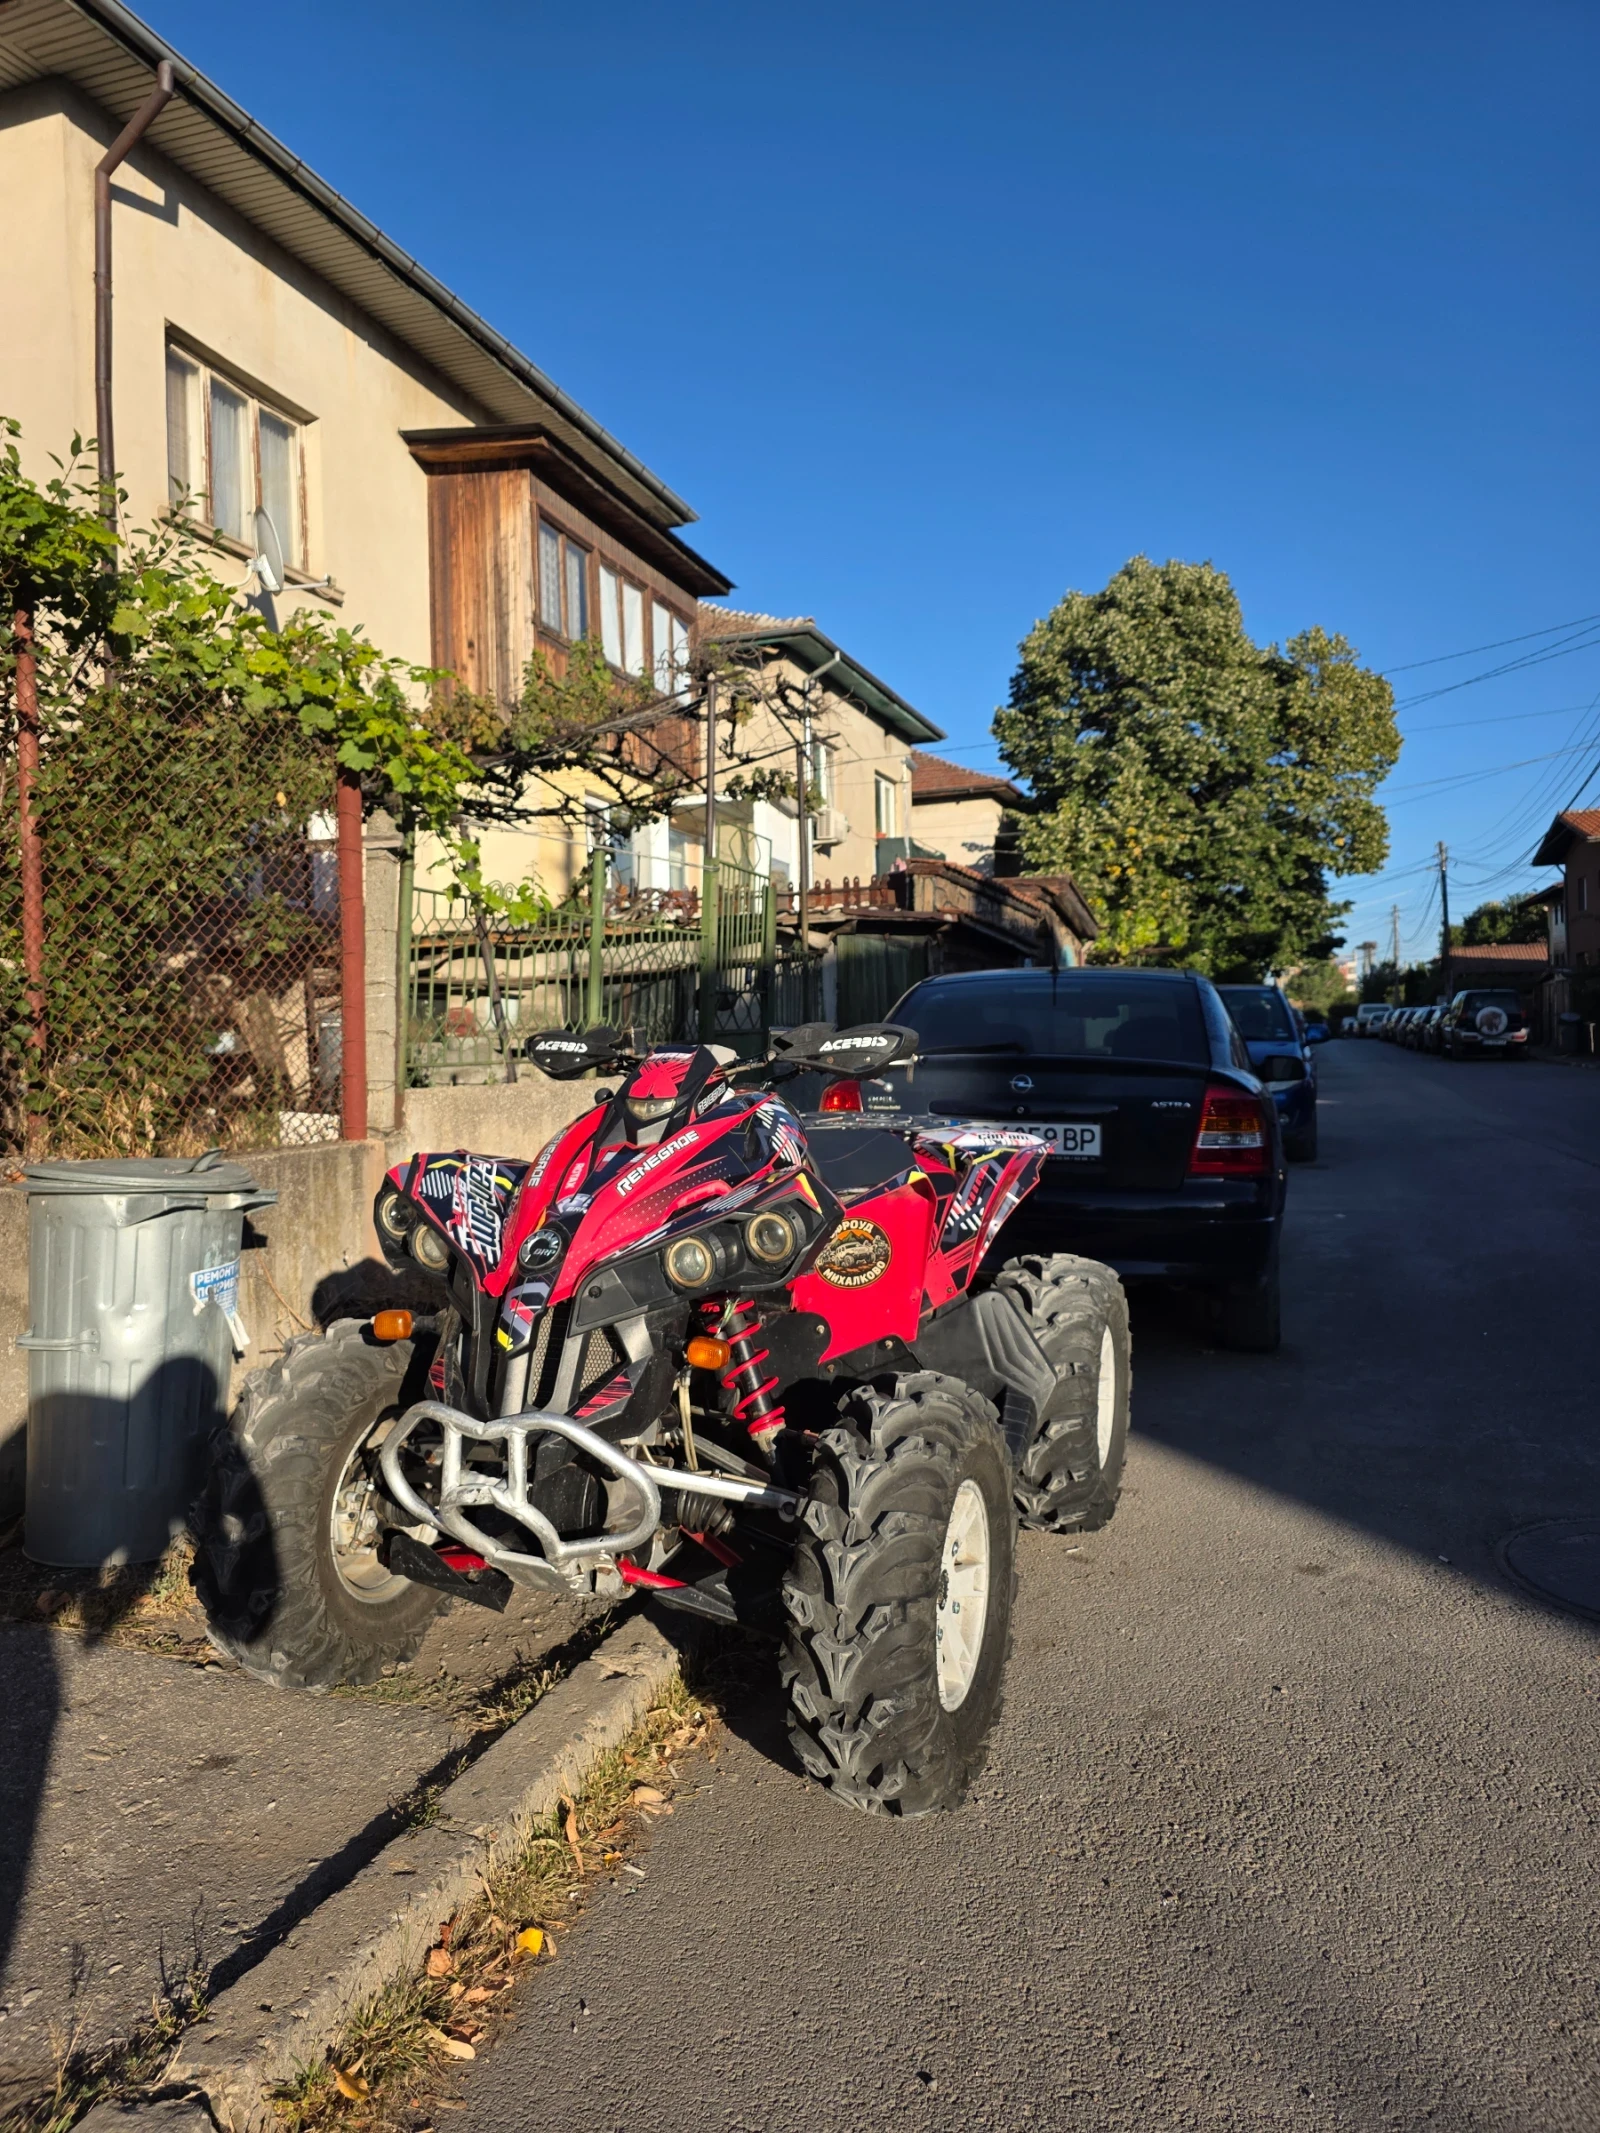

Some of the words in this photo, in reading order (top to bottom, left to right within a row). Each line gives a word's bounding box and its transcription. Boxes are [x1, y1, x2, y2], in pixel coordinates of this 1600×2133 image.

[535, 1041, 588, 1053] ACERBIS
[819, 1036, 888, 1052] ACERBIS
[527, 1129, 568, 1188] RENEGADE
[616, 1130, 700, 1197] RENEGADE
[565, 1163, 585, 1189] ROTAX
[533, 1248, 557, 1257] BRP
[197, 1265, 235, 1286] РЕМОНТ
[822, 1260, 886, 1286] МИХАЛКОВО
